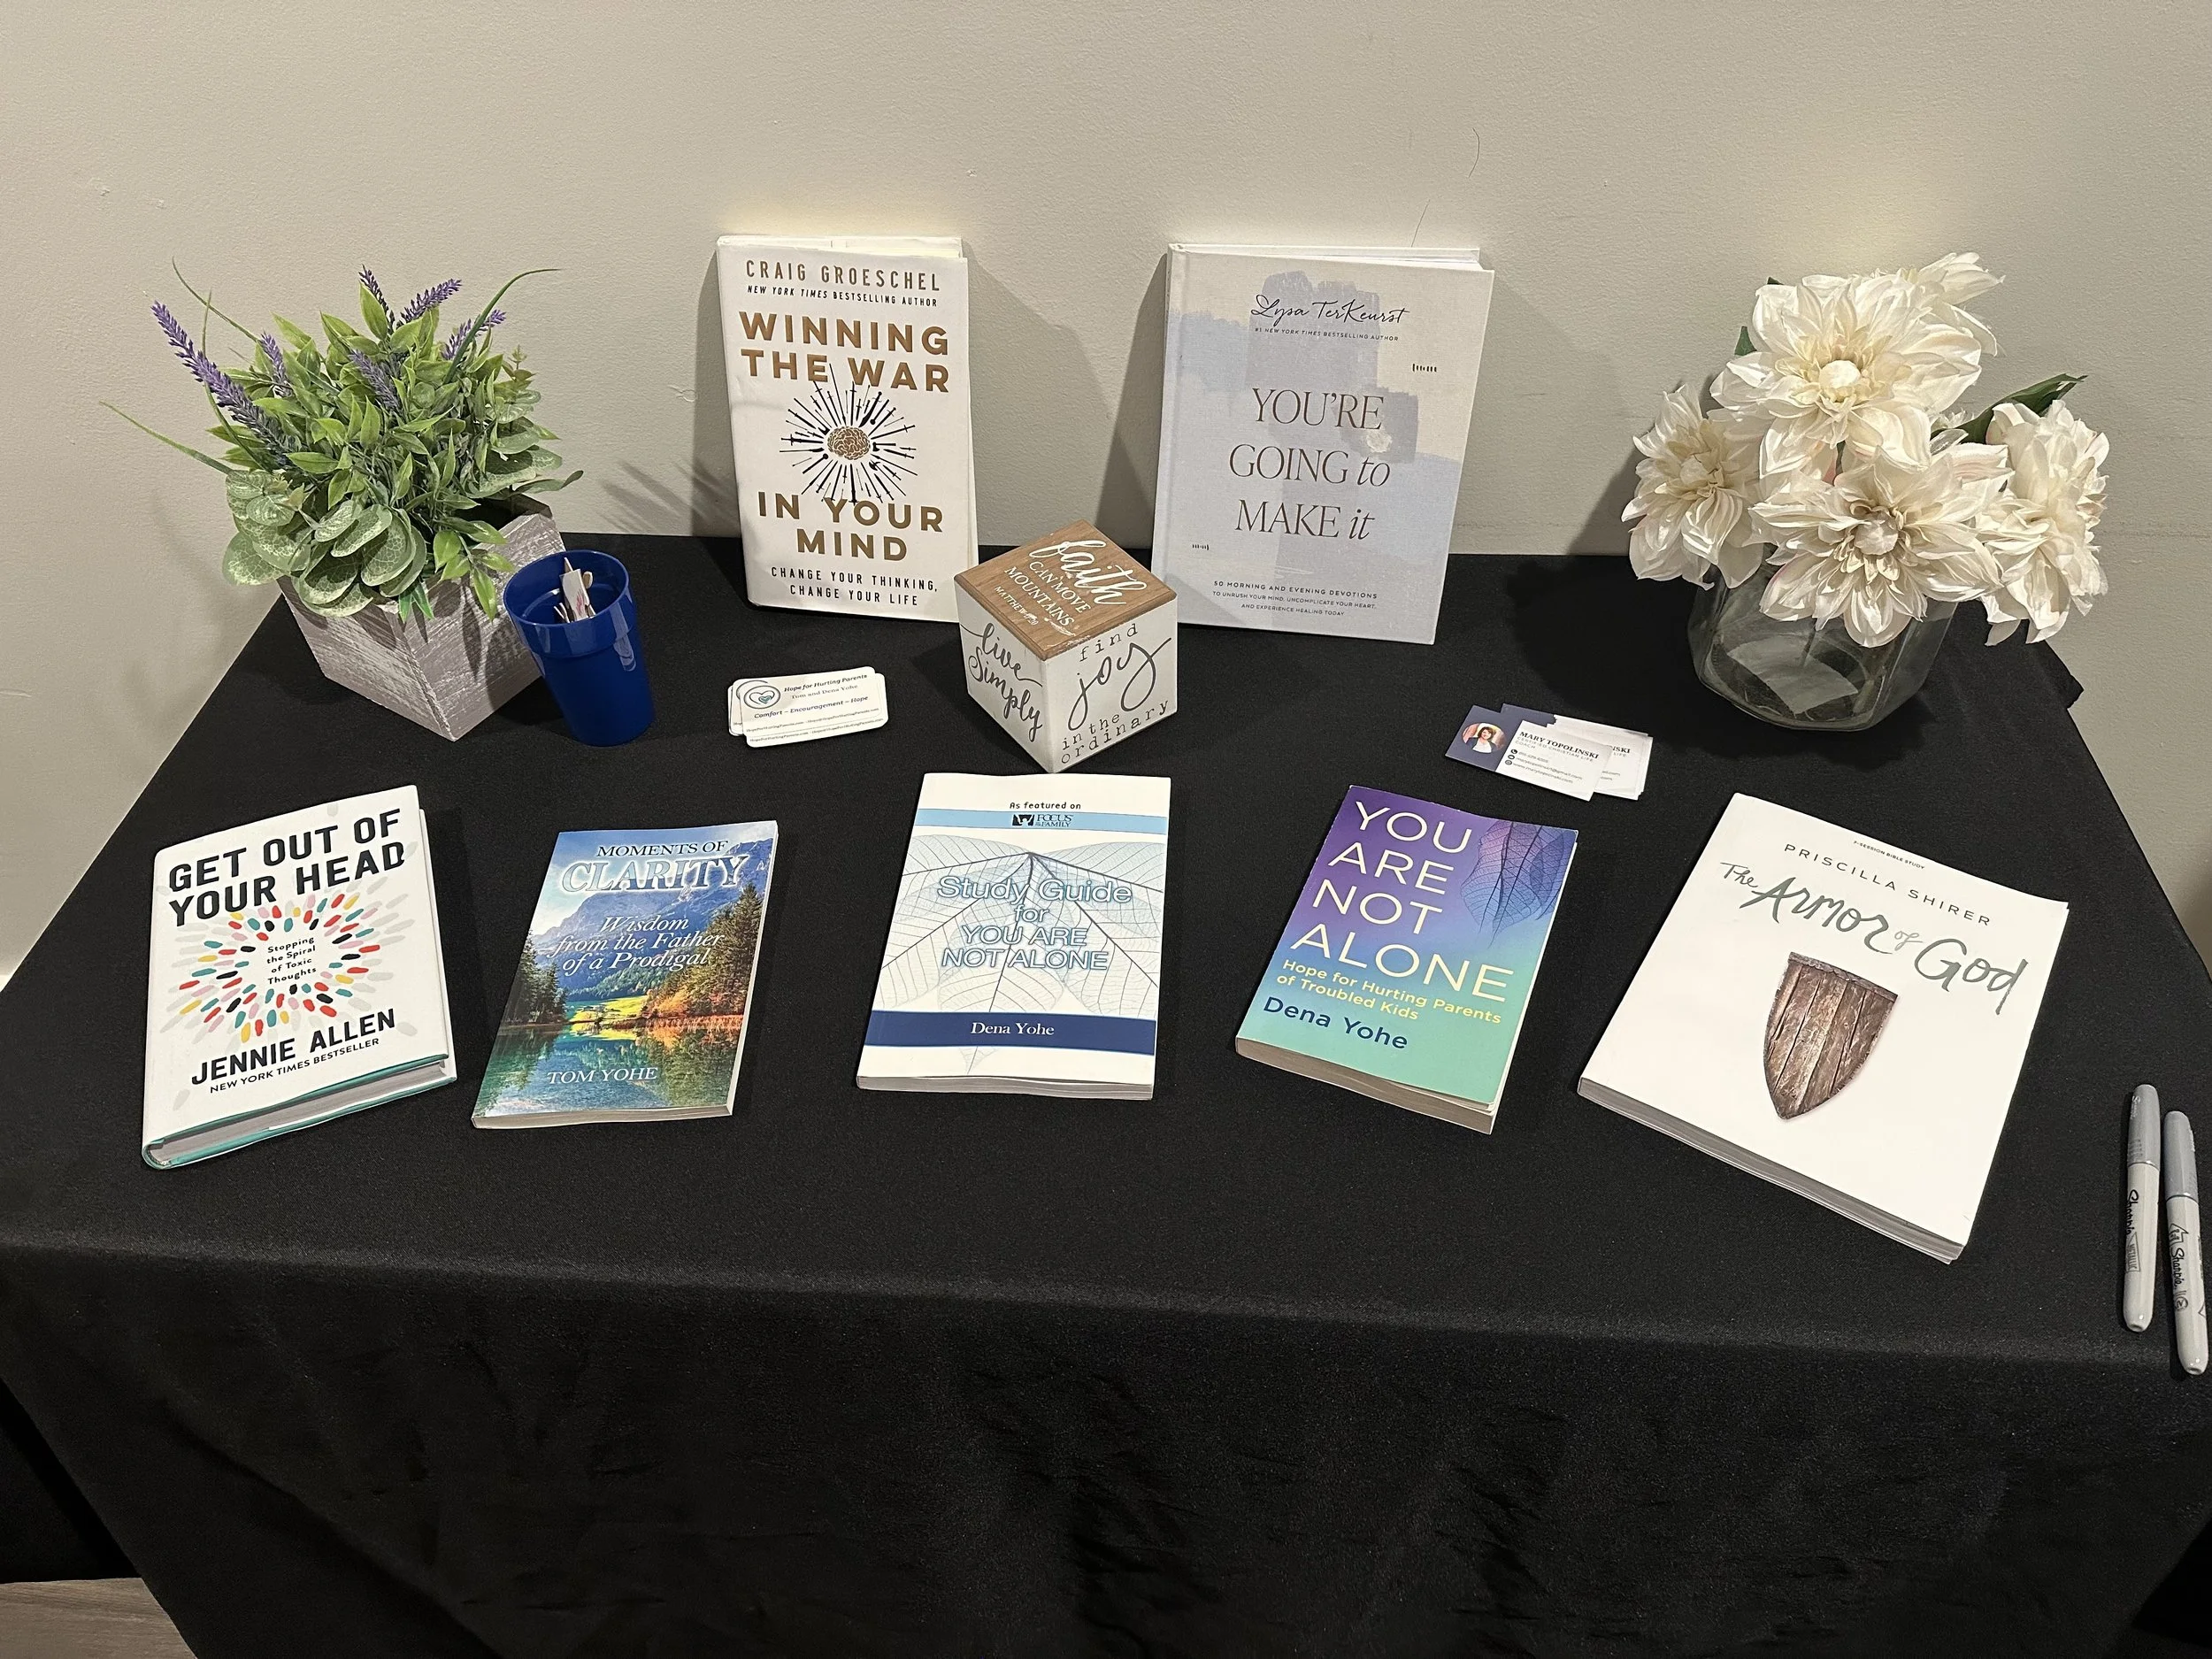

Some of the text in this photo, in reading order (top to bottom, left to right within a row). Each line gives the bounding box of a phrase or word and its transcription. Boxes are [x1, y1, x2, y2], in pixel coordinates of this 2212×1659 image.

[746, 260, 940, 291] CRAIG GROESCHEL
[748, 285, 938, 307] NEW YORK TIMES BESTSELLING AUTHOR
[1251, 294, 1410, 326] Lysa TerKeurst
[739, 311, 949, 356] WINNING
[741, 349, 949, 393] THE WAR
[1229, 443, 1391, 487] GOING to
[758, 492, 943, 533] IN YOUR
[1234, 499, 1375, 541] MAKE it
[797, 529, 908, 561] MIND
[772, 567, 938, 592] CHANGE YOUR THINKING,
[1029, 540, 1147, 605] faith
[1029, 561, 1092, 613] CAN MOVE
[790, 585, 918, 606] CHANGE YOUR LIFE
[995, 586, 1028, 615] MATTHEW
[1004, 566, 1076, 626] MOUNTAINS
[1226, 581, 1266, 590] MORNING
[1329, 589, 1378, 599] DEVOTIONS
[1286, 597, 1334, 606] UNCOMPLICATE
[959, 623, 1042, 687] live
[1079, 624, 1138, 662] find
[813, 679, 841, 688] Hurting
[841, 674, 867, 683] Parents
[1068, 637, 1171, 730] joy
[790, 700, 843, 713] Encouragement
[1061, 701, 1169, 764] ordinary
[1062, 713, 1119, 750] in the
[1519, 732, 1546, 742] MARY
[1547, 740, 1599, 759] TOPOLINSKI
[1356, 801, 1472, 853] YOU
[169, 808, 400, 893] GET OUT OF
[596, 841, 729, 856] MOMENTS OF
[1886, 853, 1903, 862] BIBLE
[1905, 860, 1925, 869] STUDY
[169, 841, 404, 926] YOUR HEAD
[562, 855, 749, 893] CLARITY
[1327, 841, 1454, 895] ARE
[1784, 843, 1990, 926] PRISCILLA SHIRER
[937, 875, 1132, 905] Study Guide
[1312, 879, 1443, 935] NOT
[600, 916, 688, 932] Wisdom
[1014, 904, 1050, 922] for
[267, 935, 315, 954] Stopping
[548, 932, 726, 958] from the Father
[962, 925, 1087, 946] YOU ARE
[1720, 862, 1758, 887] The
[1894, 931, 1924, 951] of
[1914, 939, 2029, 1015] God
[266, 945, 316, 964] the Spiral
[271, 957, 312, 974] of Toxic
[562, 949, 710, 974] of a Prodigal
[941, 947, 1109, 971] NOT ALONE
[1290, 923, 1514, 1002] ALONE
[267, 967, 317, 986] Thoughts
[1282, 959, 1502, 1024] Hope for Hurting Parents
[1277, 974, 1419, 1021] of Troubled Kids
[971, 1022, 1055, 1035] Dena Yohe
[1263, 996, 1408, 1049] Dena Yohe
[191, 1008, 396, 1086] JENNIE ALLEN
[210, 1038, 380, 1094] NEW YORK TIMES BESTSELLER
[547, 1067, 657, 1084] TOM YOHE
